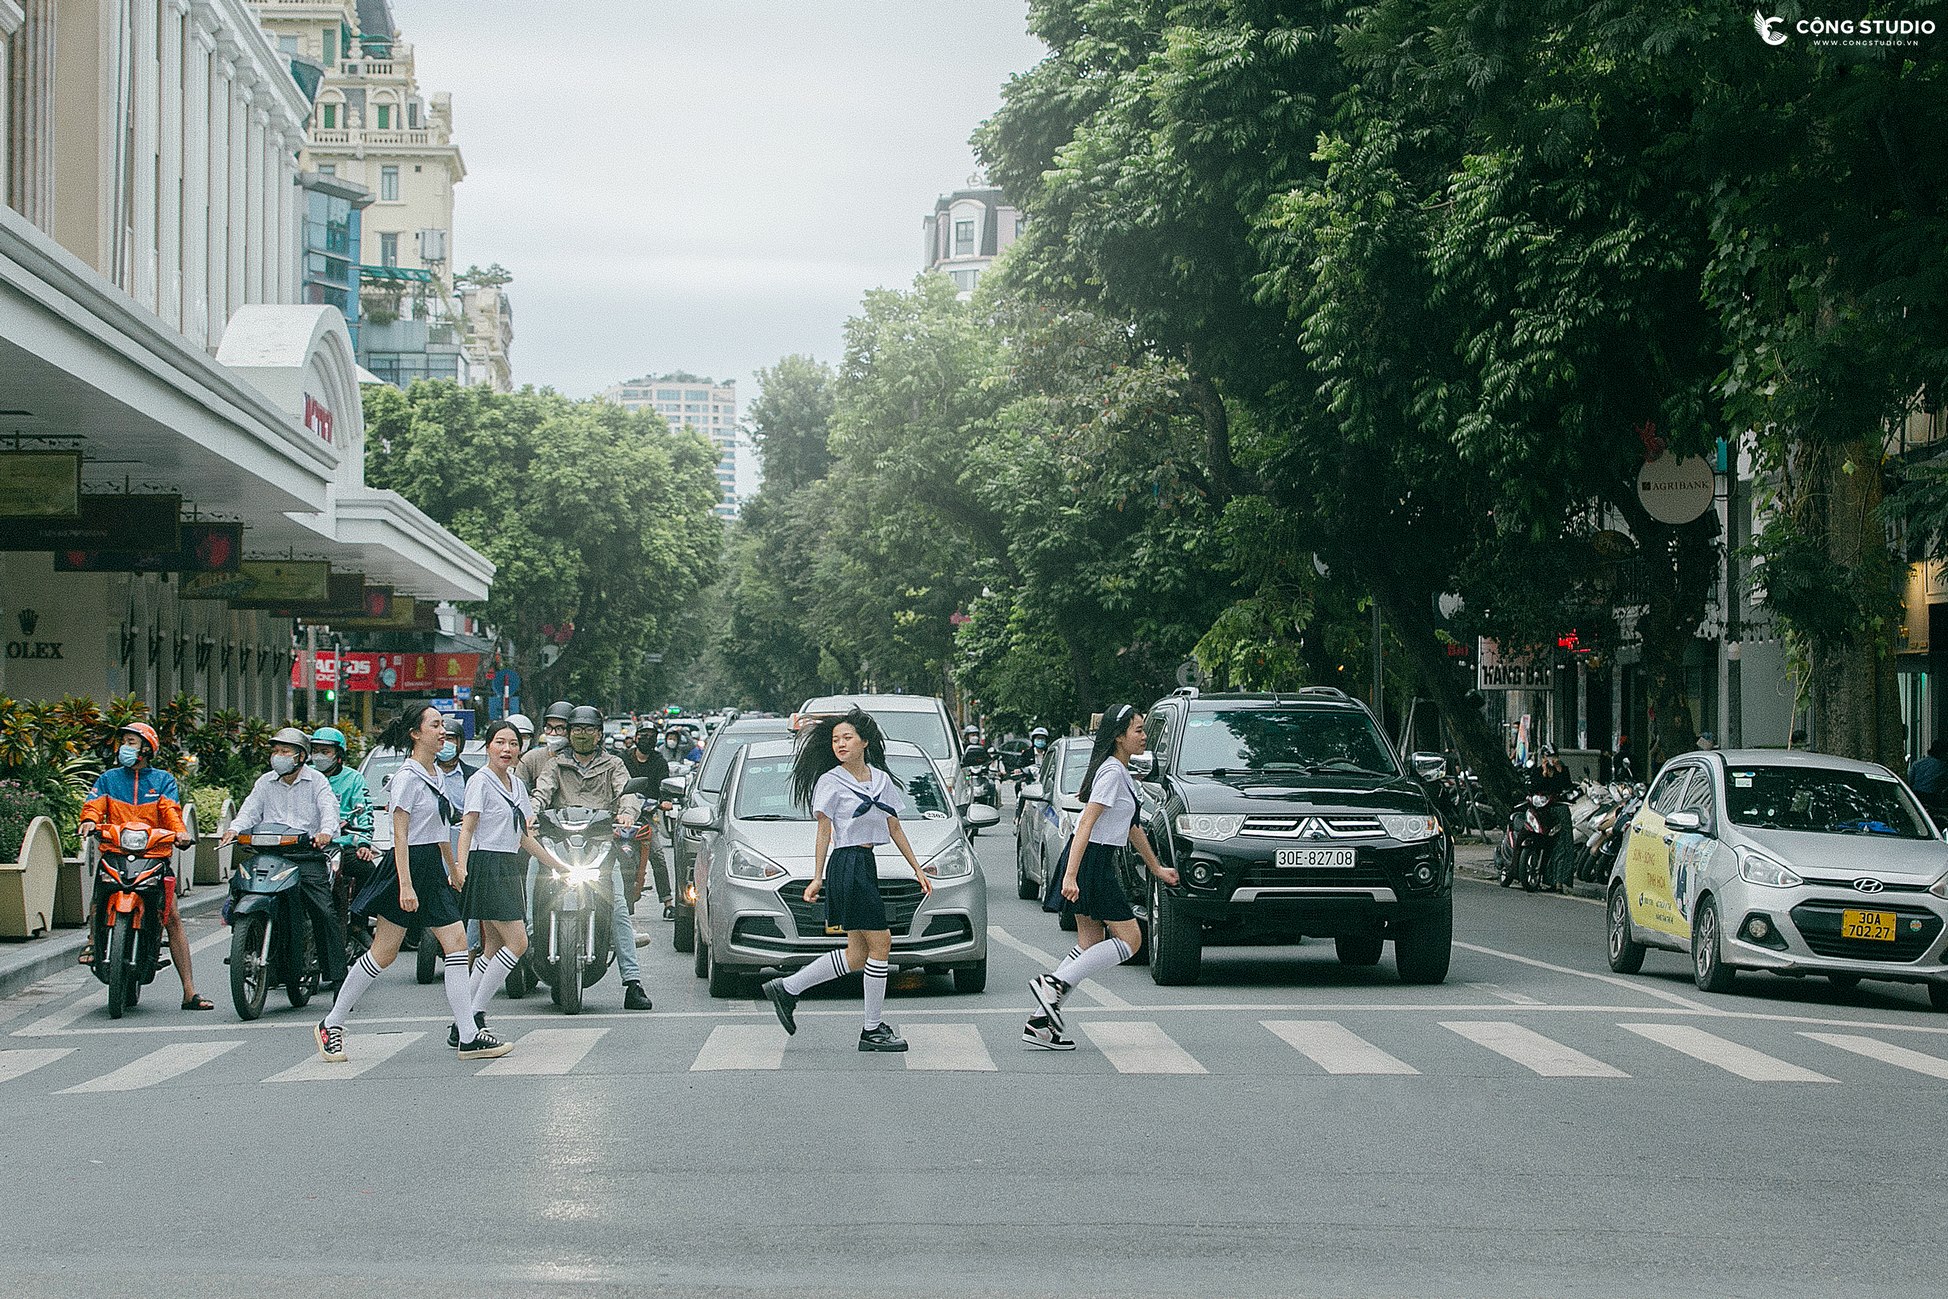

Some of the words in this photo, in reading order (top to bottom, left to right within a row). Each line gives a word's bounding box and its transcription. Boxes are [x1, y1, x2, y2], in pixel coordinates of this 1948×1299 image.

[1653, 481, 1709, 491] AGRIBANK
[5, 641, 64, 659] OLEX
[1278, 851, 1353, 866] 30E-827.08
[1858, 912, 1881, 926] 30A
[1848, 924, 1891, 939] 702.27
